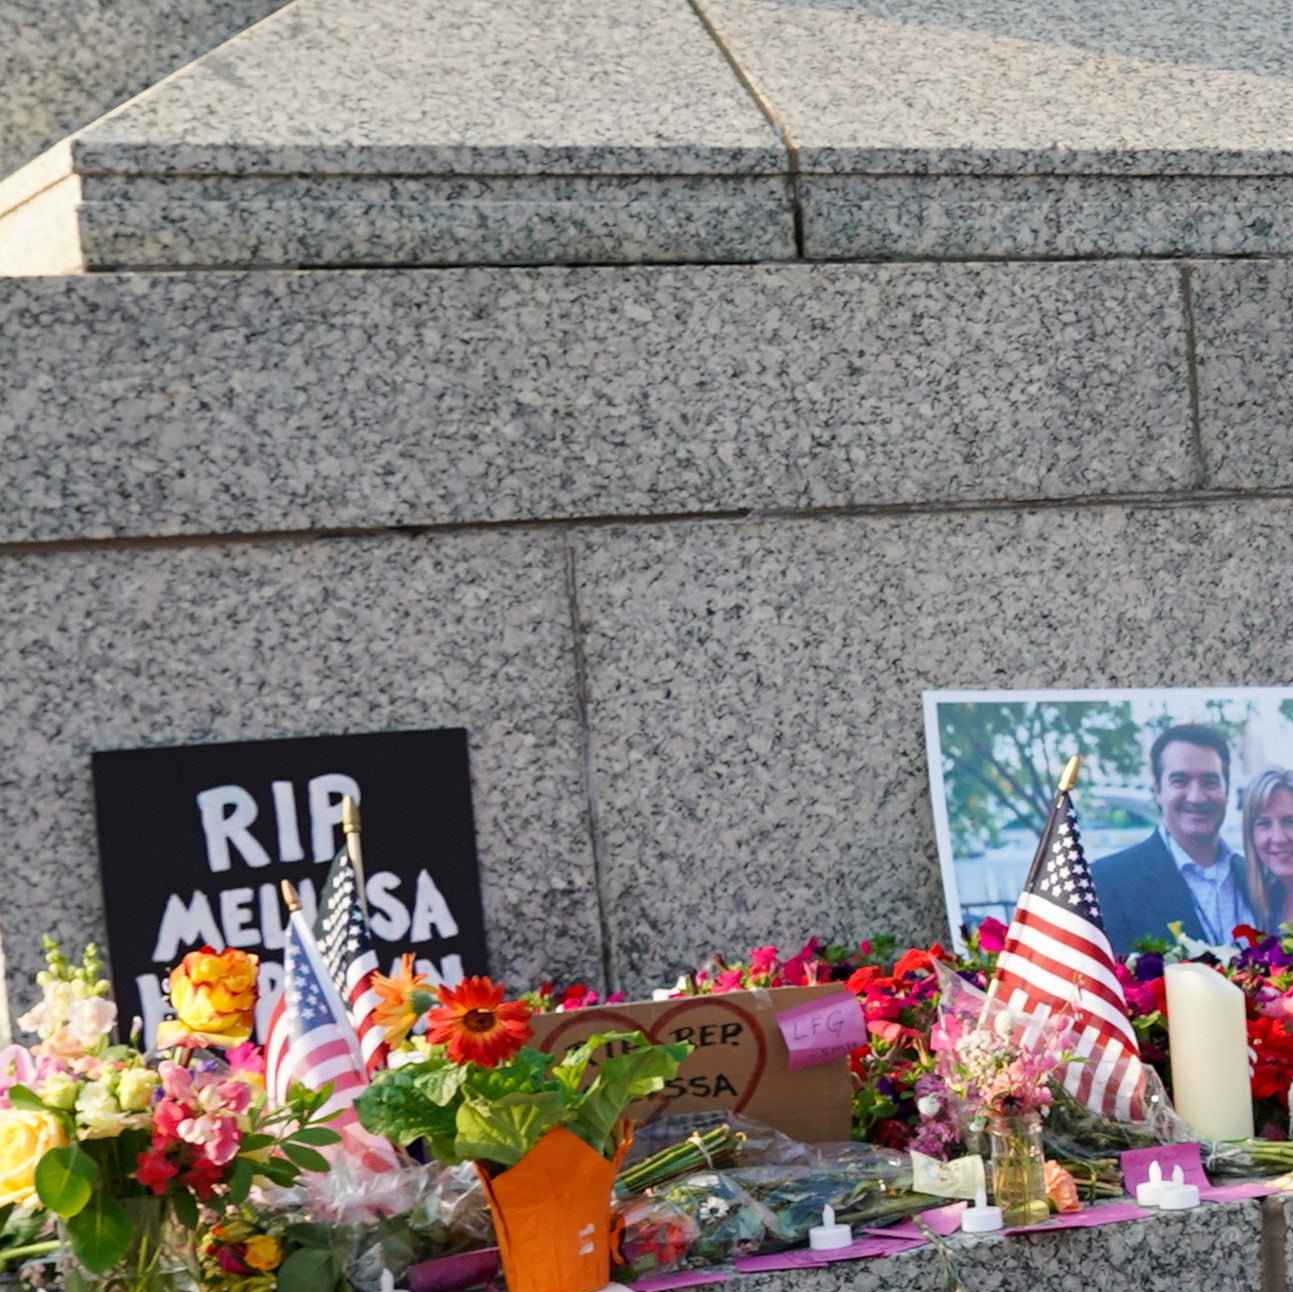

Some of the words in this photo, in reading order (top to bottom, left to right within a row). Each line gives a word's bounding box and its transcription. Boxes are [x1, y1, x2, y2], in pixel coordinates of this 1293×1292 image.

[196, 773, 361, 873] RIP
[151, 869, 459, 962] MELISA
[793, 1010, 844, 1041] LFG
